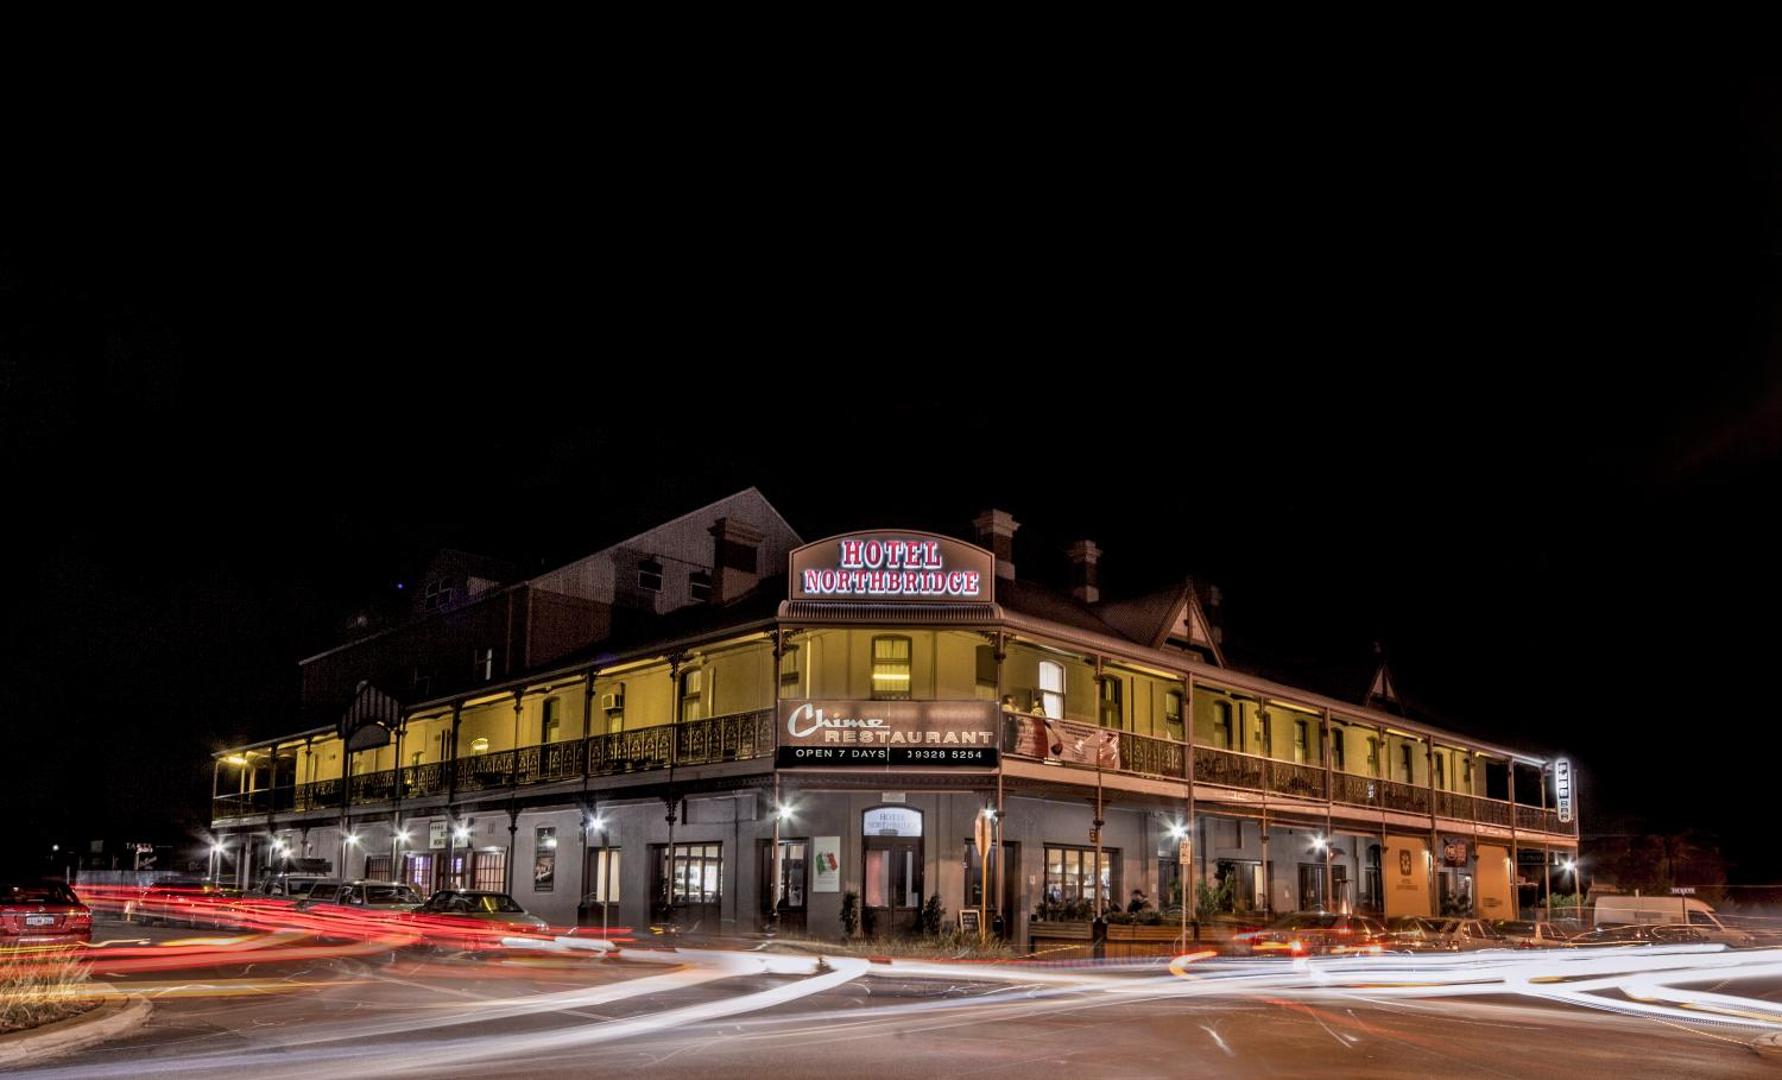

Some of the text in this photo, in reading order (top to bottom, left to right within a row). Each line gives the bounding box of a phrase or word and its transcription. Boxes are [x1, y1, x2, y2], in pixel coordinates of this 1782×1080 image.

[841, 539, 942, 568] HOTEL
[804, 569, 979, 595] NORTHBRIDGE
[787, 703, 890, 737] Chime
[824, 730, 994, 744] RESTAURANT
[795, 749, 833, 758] OPEN
[839, 750, 846, 758] 7
[852, 749, 886, 758] DAYS
[951, 750, 982, 759] 5254
